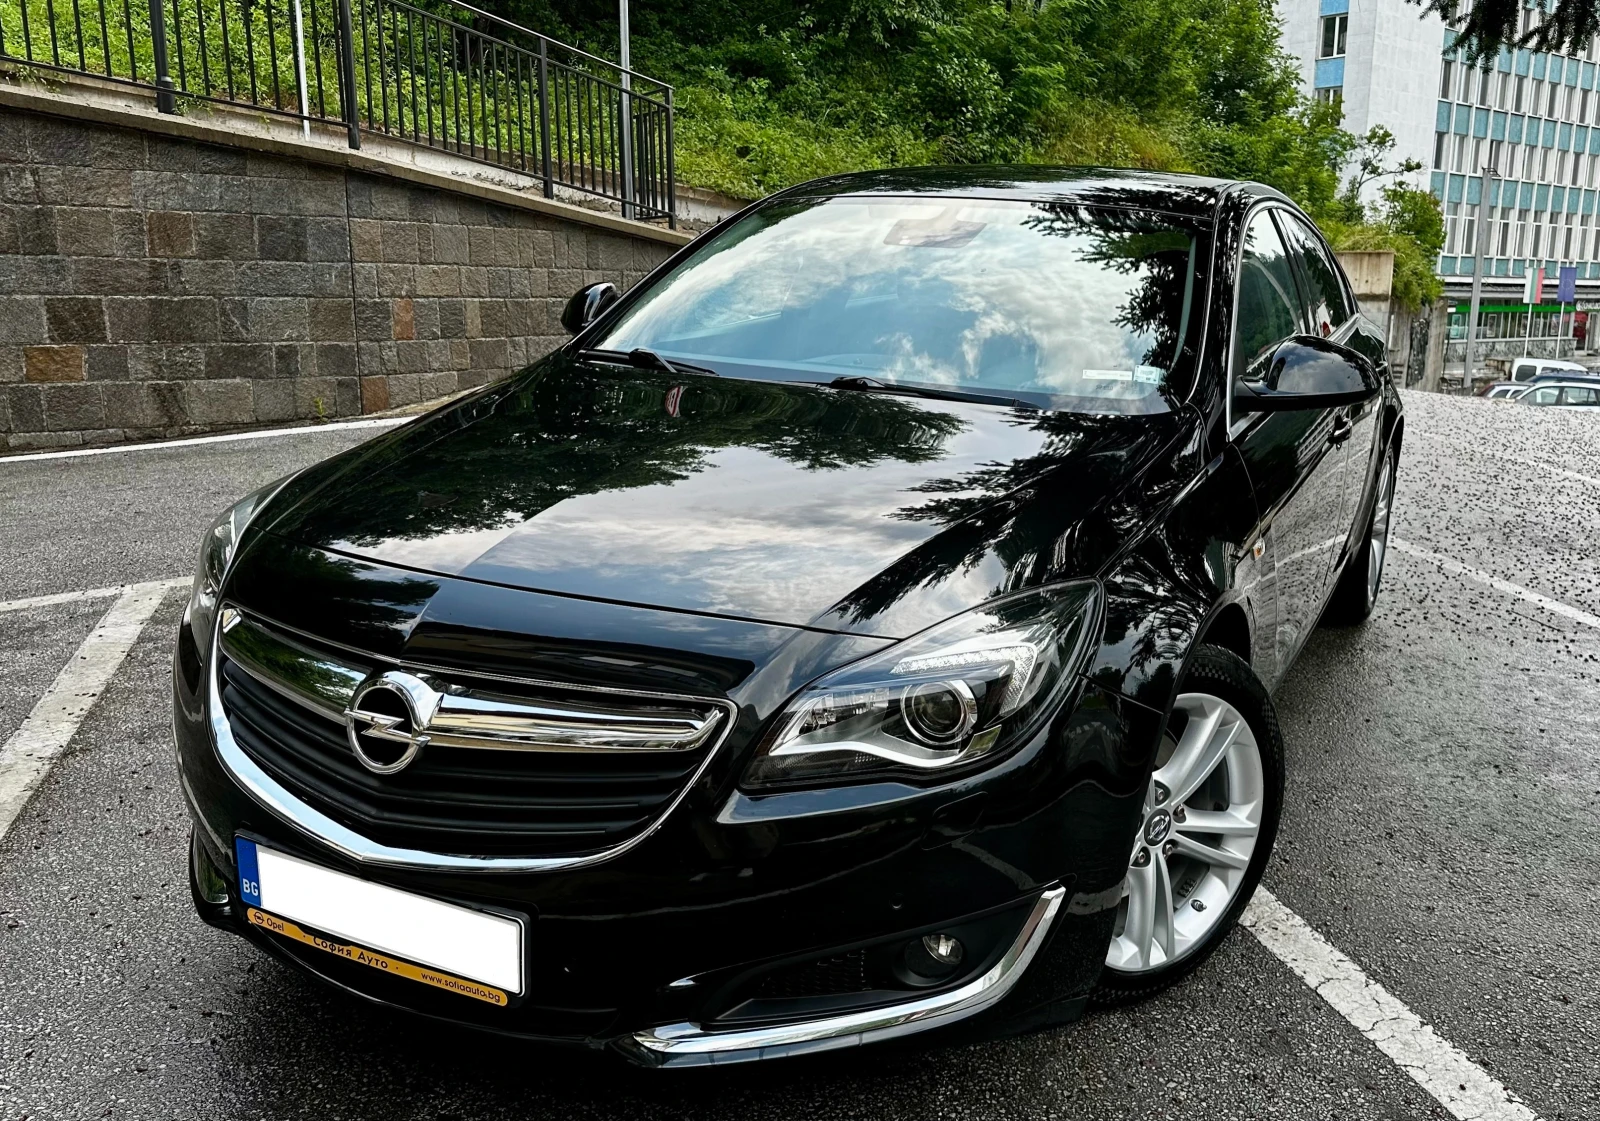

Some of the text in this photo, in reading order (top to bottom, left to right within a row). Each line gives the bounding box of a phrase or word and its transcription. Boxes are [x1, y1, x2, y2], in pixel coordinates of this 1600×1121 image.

[242, 878, 259, 896] BG
[266, 917, 284, 931] Opel
[313, 936, 389, 969] София Ауто
[421, 972, 501, 1003] www.sofiaauto.bg
